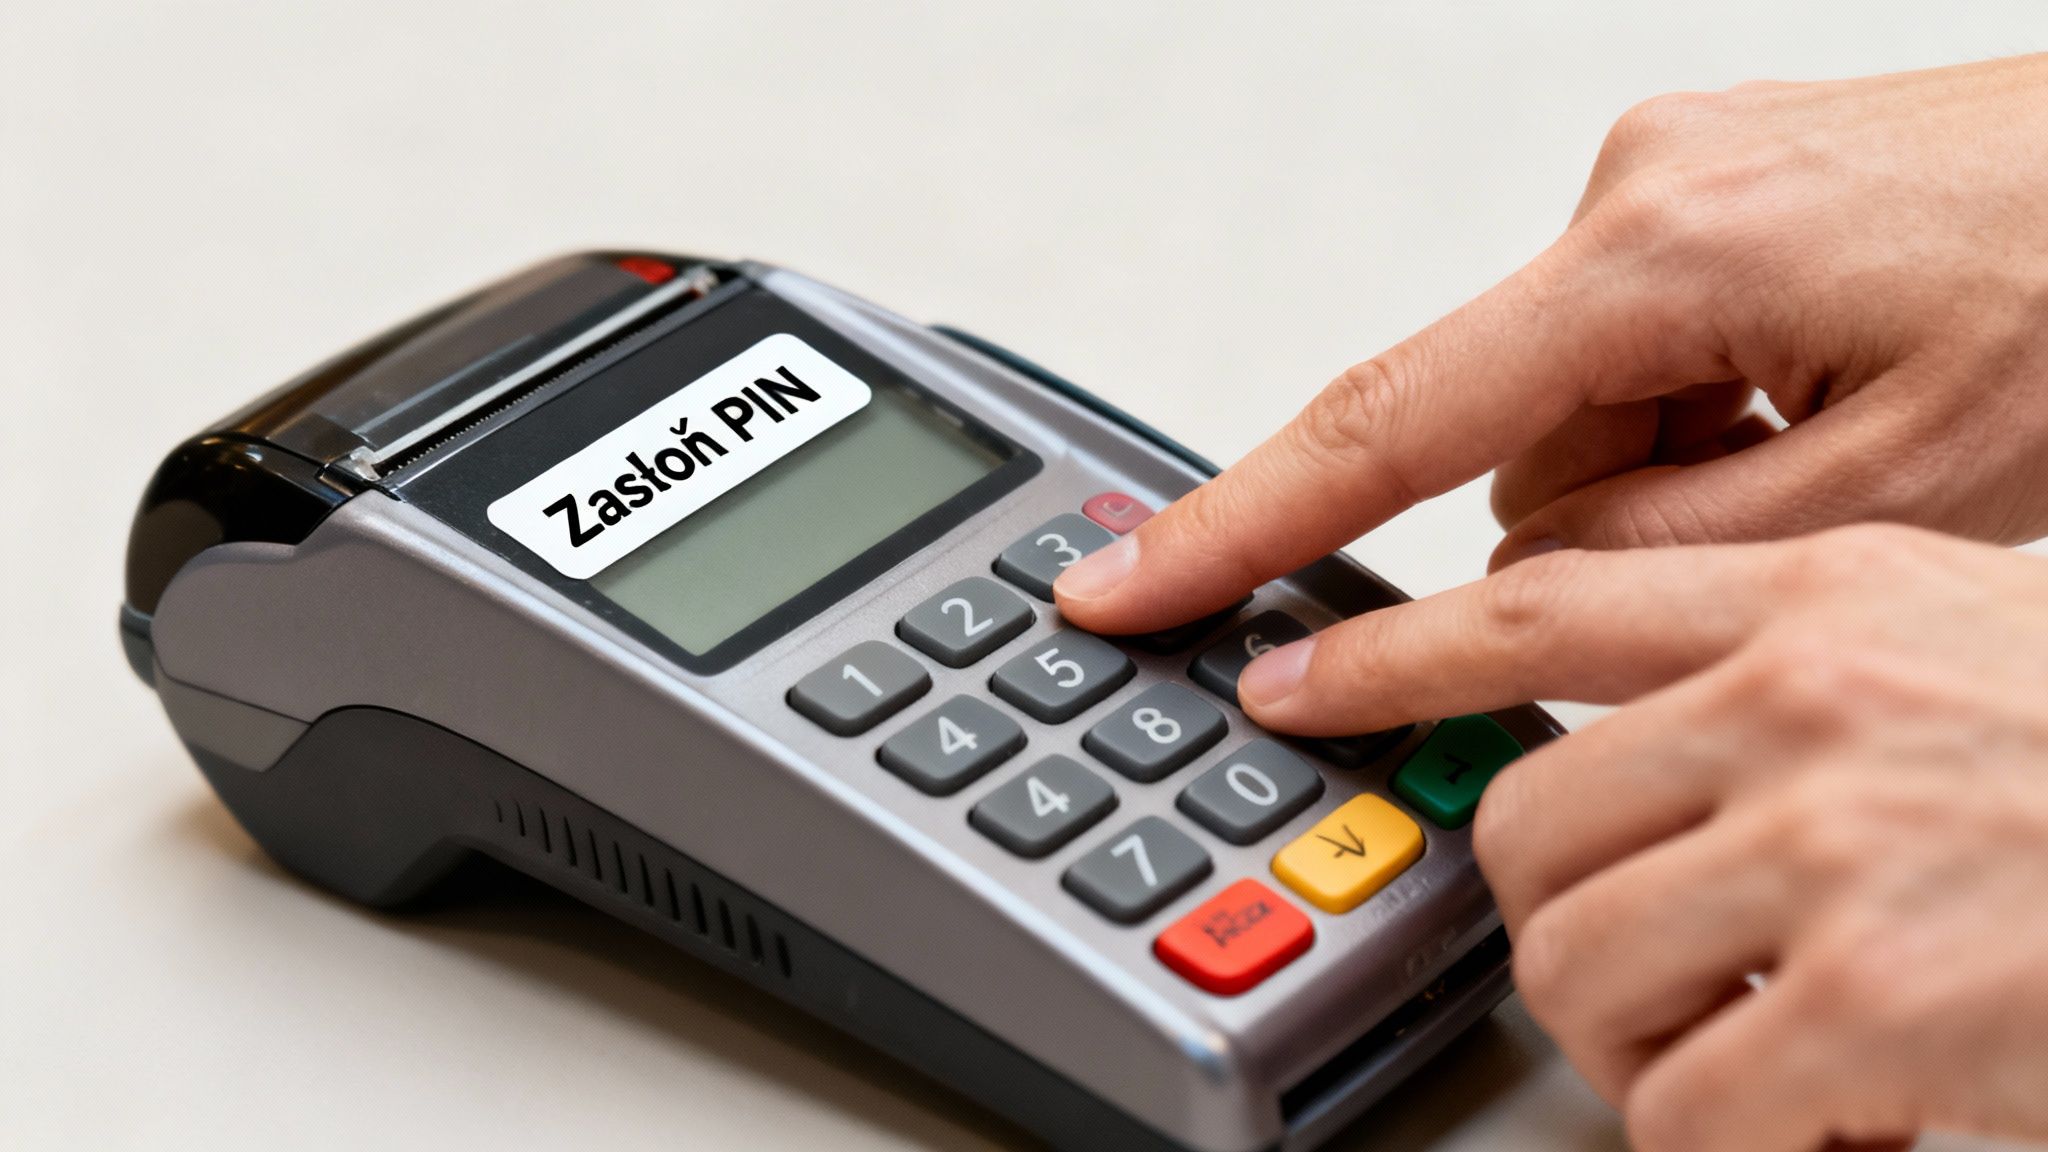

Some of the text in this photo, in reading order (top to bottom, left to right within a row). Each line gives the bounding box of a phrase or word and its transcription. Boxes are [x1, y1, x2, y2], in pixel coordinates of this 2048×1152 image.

[711, 366, 822, 443] PIN
[1036, 533, 1082, 568] 3
[941, 597, 994, 637] 2
[842, 664, 884, 697] 1
[1034, 648, 1085, 688] 5
[937, 716, 978, 755] 4
[1132, 707, 1182, 744] 8
[1026, 776, 1070, 817] 4
[1226, 763, 1279, 806] 0
[1111, 834, 1158, 887] 7
